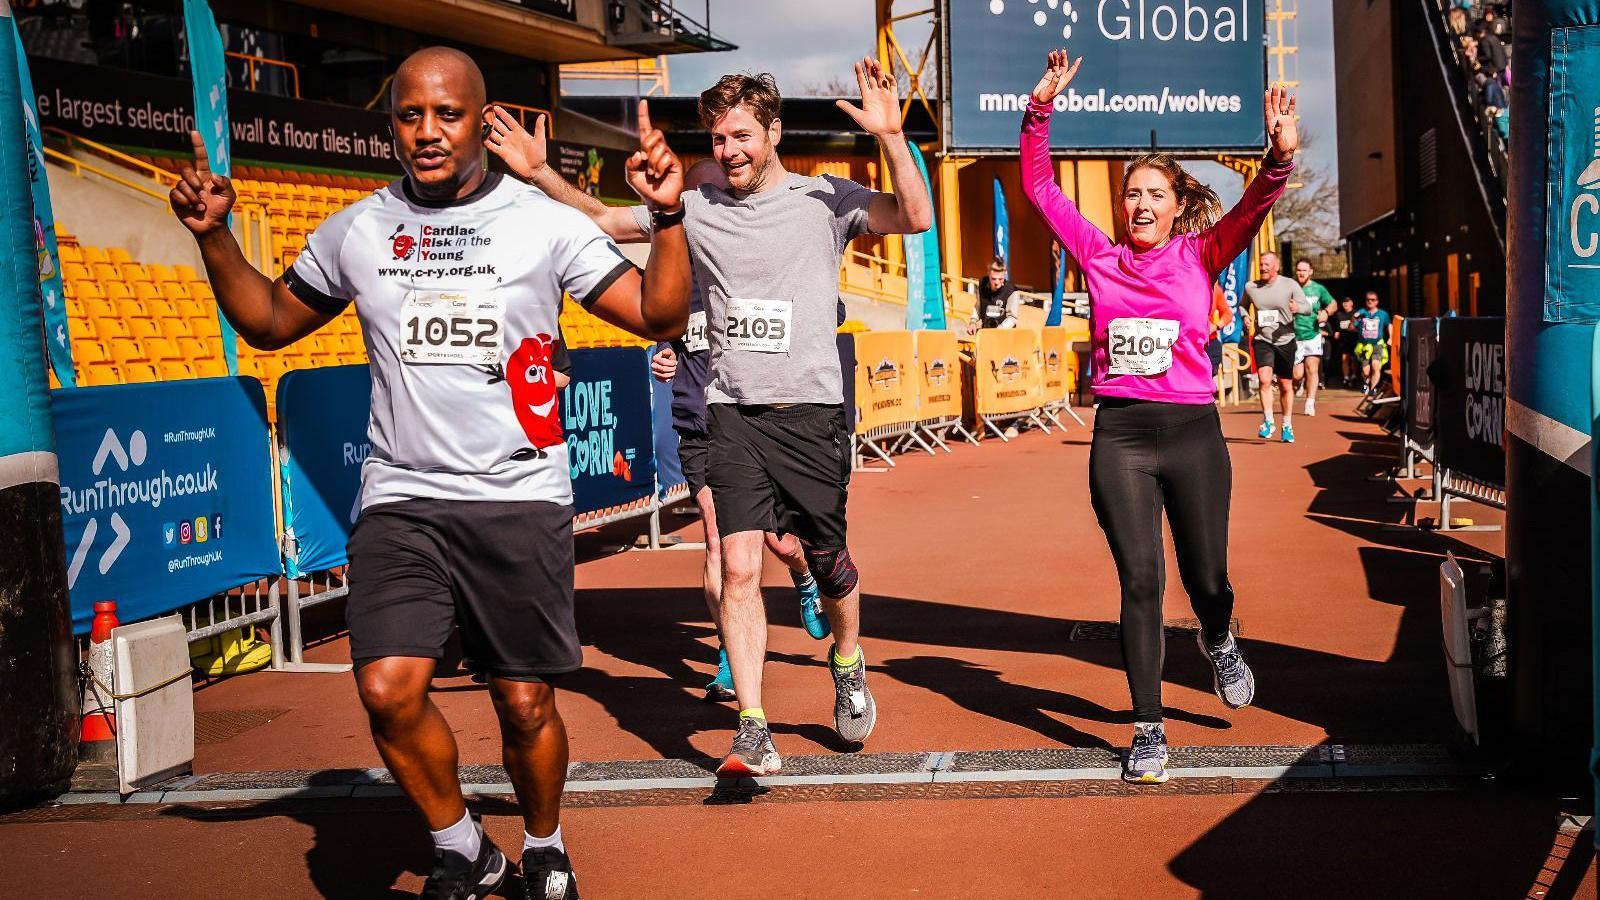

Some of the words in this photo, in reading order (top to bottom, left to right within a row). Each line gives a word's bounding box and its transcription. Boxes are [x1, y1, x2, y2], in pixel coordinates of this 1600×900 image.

[1097, 0, 1248, 42] Global
[979, 86, 1242, 115] mneobal.com/wolves
[56, 88, 124, 128] largest
[232, 117, 264, 144] wall
[268, 120, 281, 146] &
[284, 122, 319, 150] floor
[322, 127, 351, 155] tiles
[353, 131, 367, 156] in
[369, 133, 391, 159] the
[421, 237, 453, 247] Risk
[455, 238, 467, 247] in
[470, 236, 491, 246] the
[423, 225, 476, 236] Cardiac
[421, 250, 464, 261] Young
[378, 264, 497, 279] www.c-r-y.org.uk
[406, 316, 498, 348] 1052
[726, 315, 786, 340] 2103
[1112, 333, 1173, 357] 2104
[564, 379, 618, 431] LOVE,
[164, 427, 216, 443] #RunThroughUK
[567, 428, 614, 480] CORN
[60, 462, 218, 515] RunThrough.co.uk
[168, 550, 223, 573] @RunThroughUK
